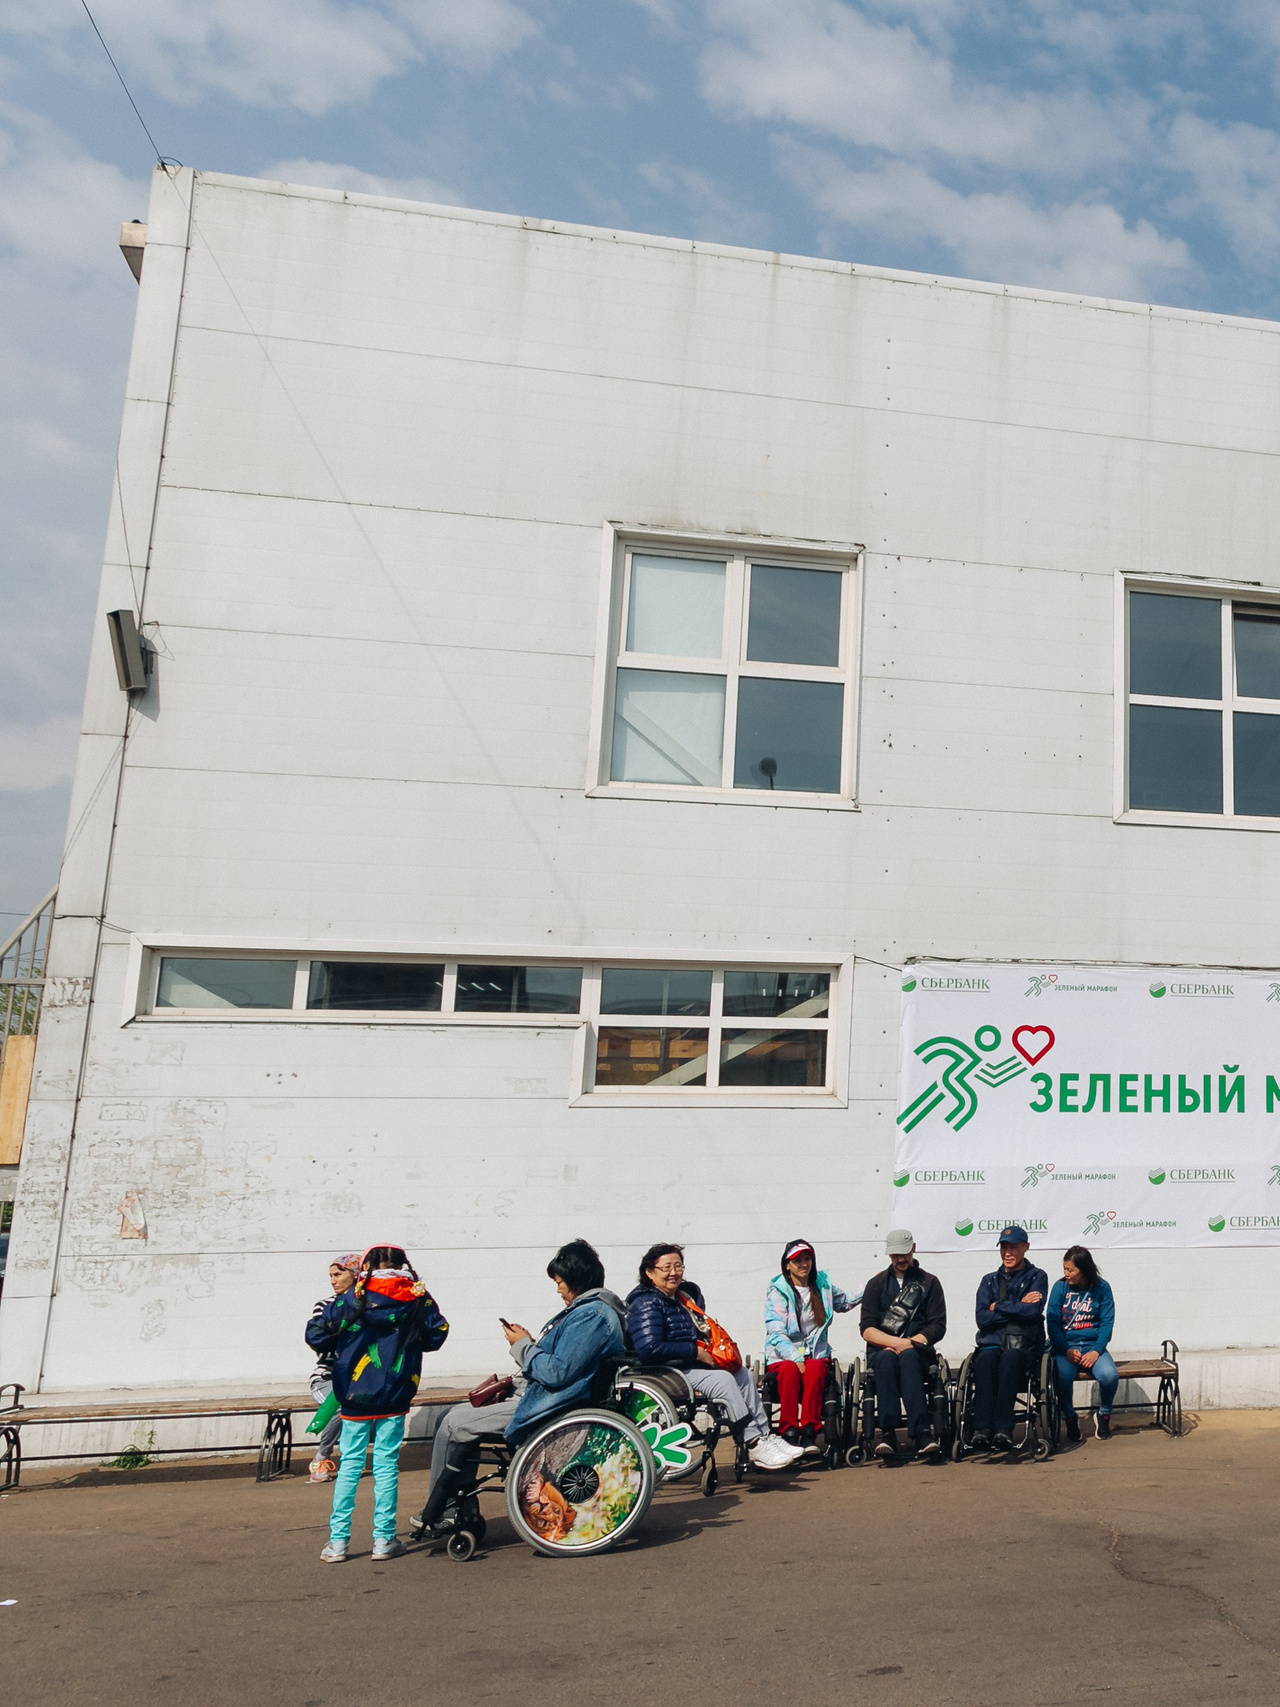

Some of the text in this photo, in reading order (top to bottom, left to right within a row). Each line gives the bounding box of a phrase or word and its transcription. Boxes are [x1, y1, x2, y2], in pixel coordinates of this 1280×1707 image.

[921, 977, 990, 990] СБЕРБАНК
[1053, 983, 1118, 993] ЗЕЛЕНЫЙ МАРАФОН
[1170, 982, 1235, 996] СБЕРБАНК
[1028, 1064, 1246, 1114] ЗЕЛЕНЫЙ
[914, 1170, 986, 1182] СБЕРБАНК
[1050, 1172, 1117, 1182] ЗЕЛЕНЫЙ МАРАФОН
[1169, 1168, 1236, 1181] СБЕРБАНК
[1112, 1219, 1177, 1229] ЗЕЛЕНЫЙ МАРАФОН
